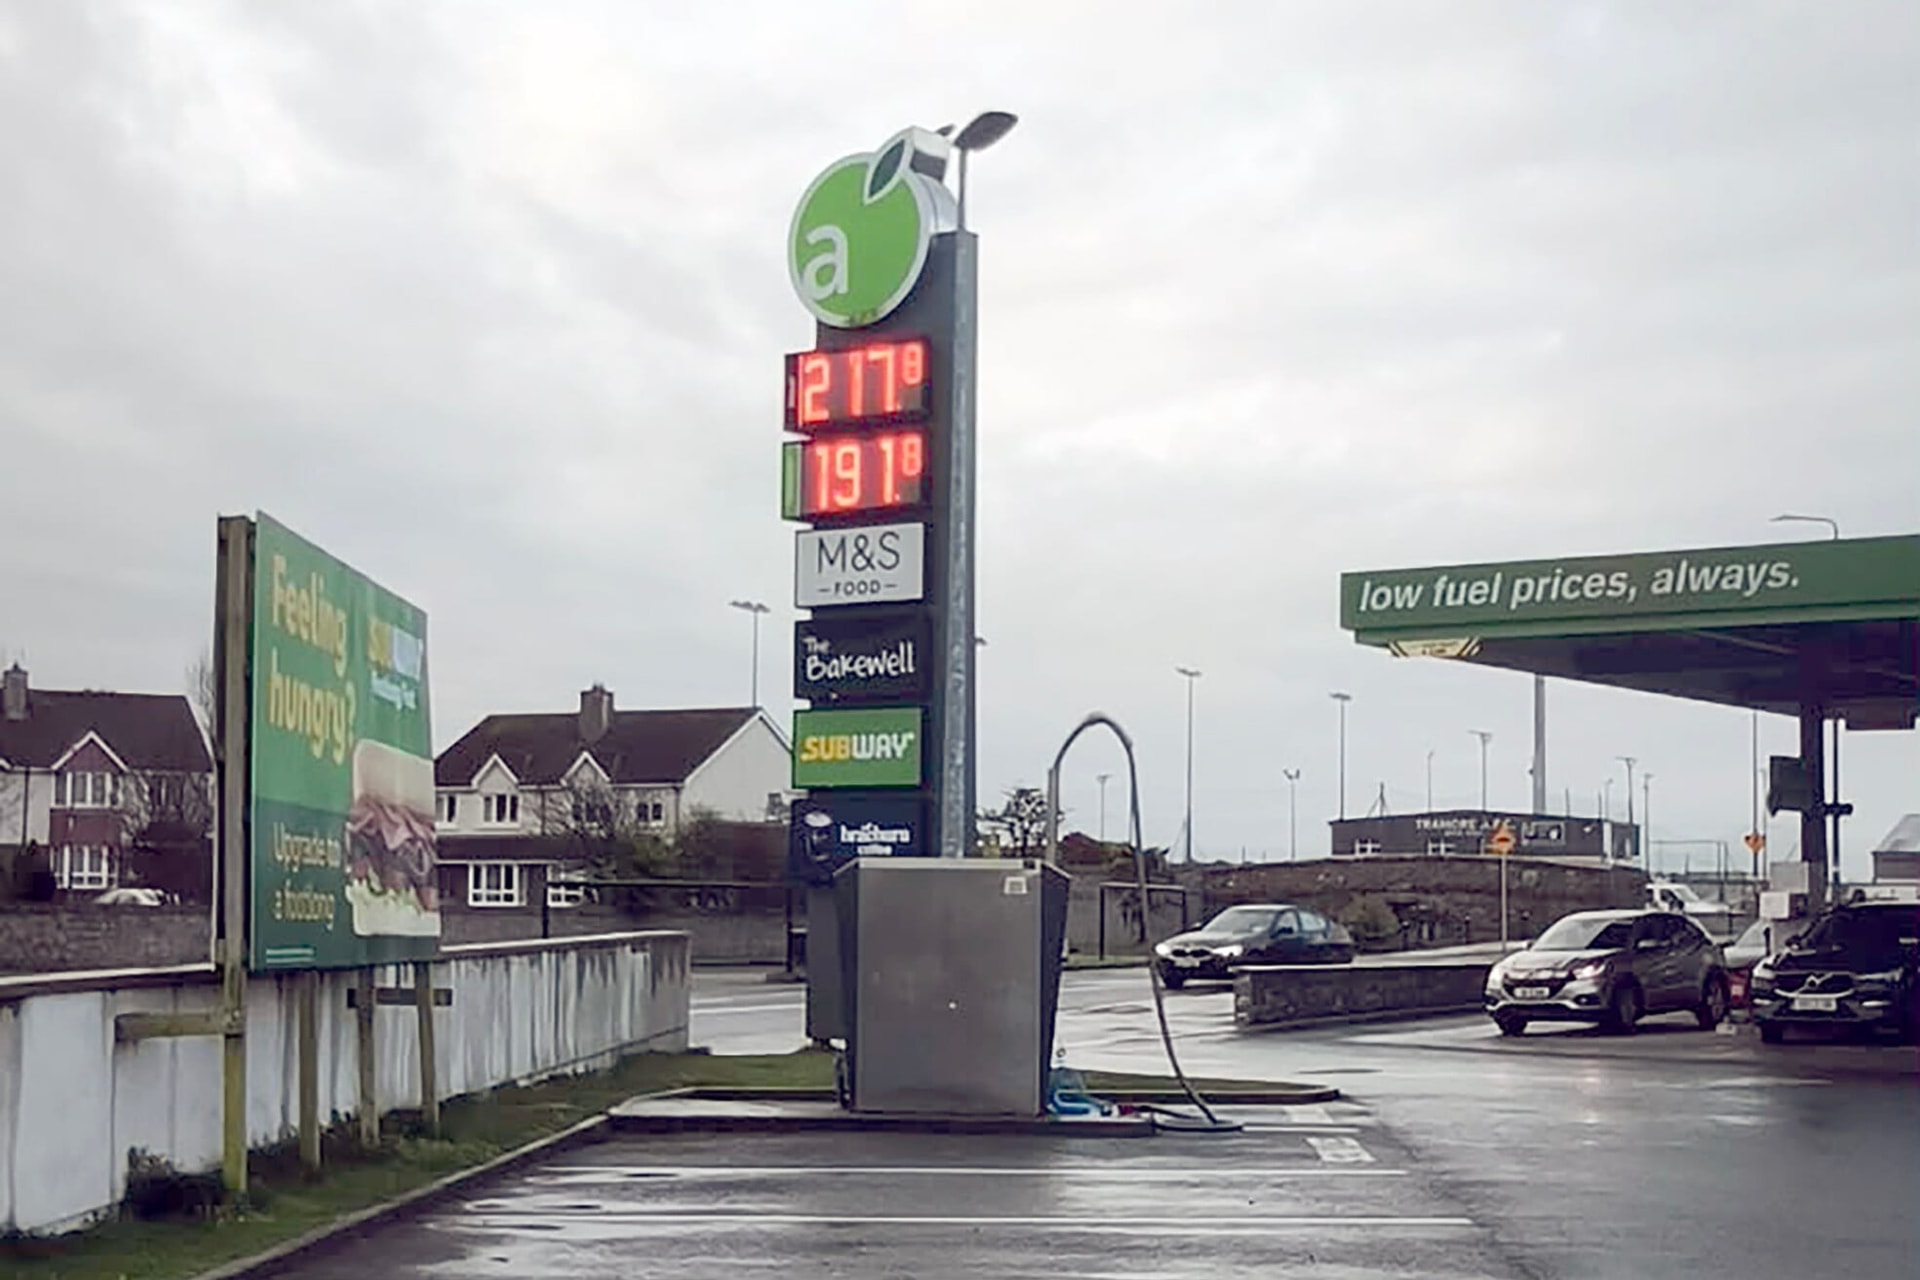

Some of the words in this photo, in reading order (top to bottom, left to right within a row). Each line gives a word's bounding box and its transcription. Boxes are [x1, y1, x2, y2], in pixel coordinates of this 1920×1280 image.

[817, 531, 900, 574] M&S
[1358, 578, 1424, 613] low
[1432, 570, 1504, 608] fuel
[1508, 567, 1639, 611] prices,
[1649, 558, 1800, 596] always.
[272, 554, 348, 679] Feeling
[805, 640, 916, 682] Bakewell
[269, 645, 356, 766] hungry?
[800, 733, 916, 762] SUBWAY
[273, 821, 325, 873] Upgrade
